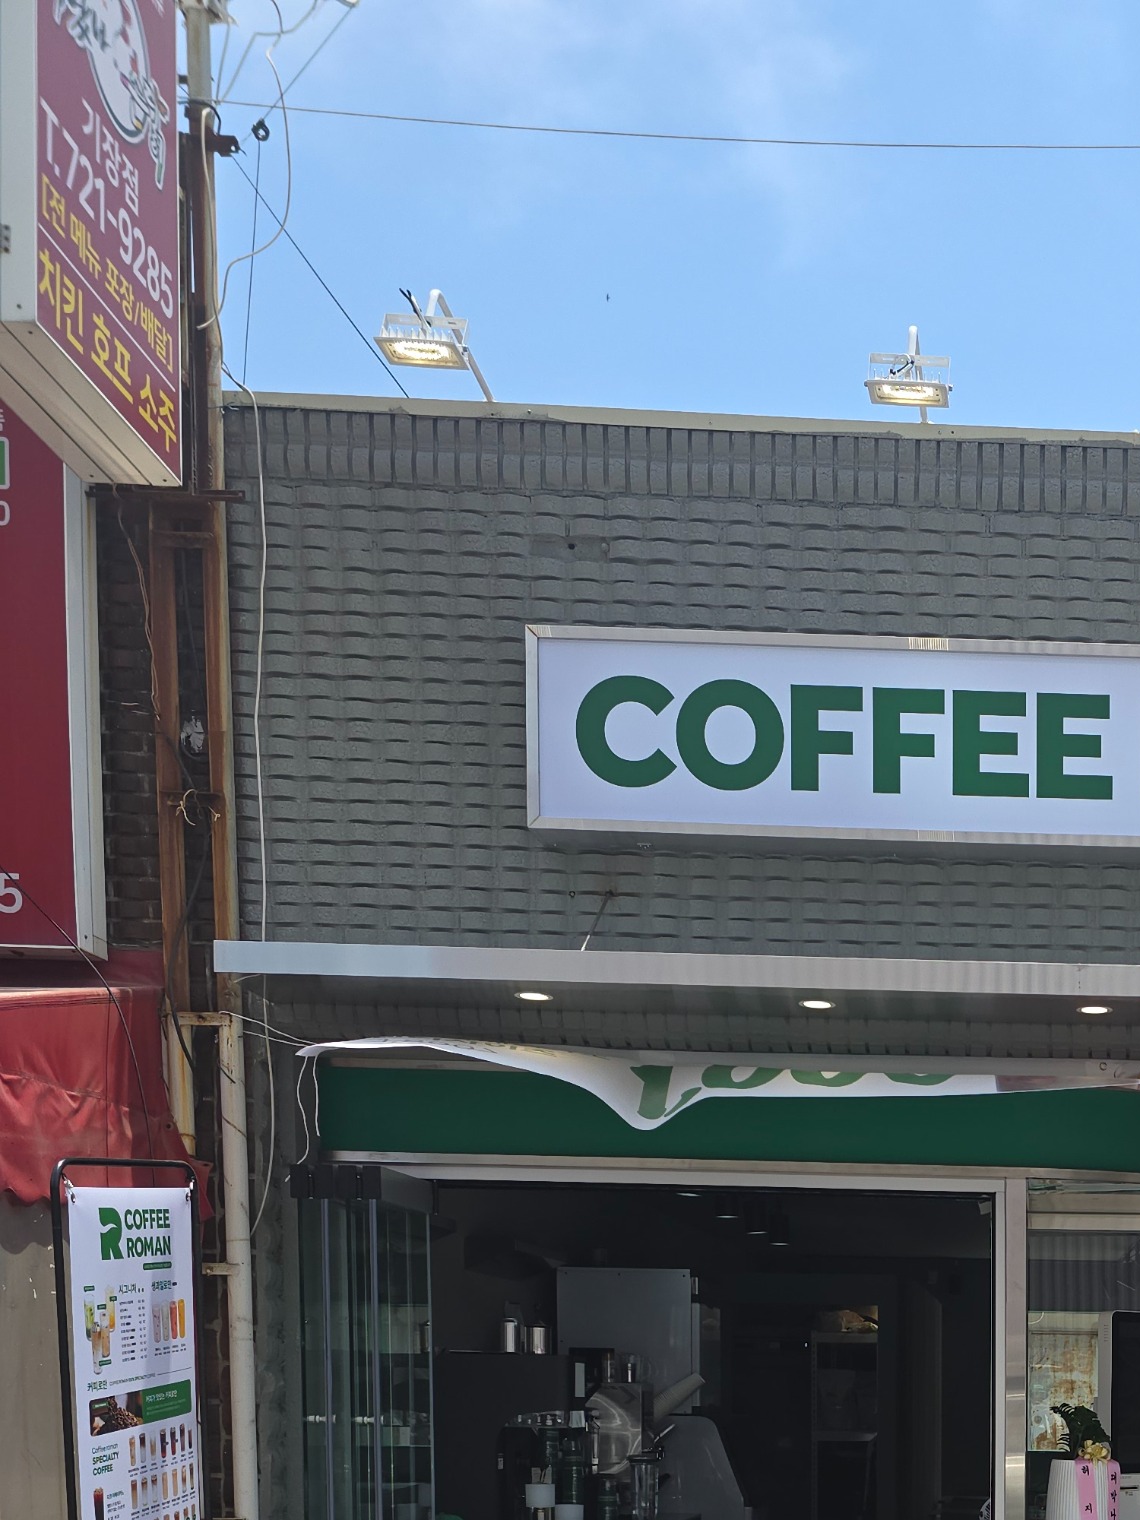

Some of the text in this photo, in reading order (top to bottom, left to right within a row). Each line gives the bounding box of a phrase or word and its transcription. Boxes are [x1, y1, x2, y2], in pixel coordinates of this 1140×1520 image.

[82, 97, 139, 217] 기장점
[40, 95, 174, 319] T.721-9285
[70, 212, 102, 280] 메뉴
[39, 248, 177, 453] 치킨 호프 소주
[576, 674, 1114, 801] COFFEE
[124, 1209, 171, 1230] COFFEE
[126, 1235, 172, 1258] ROMAN
[92, 1451, 120, 1465] SPECIALTY
[92, 1463, 114, 1476] COFFEE
